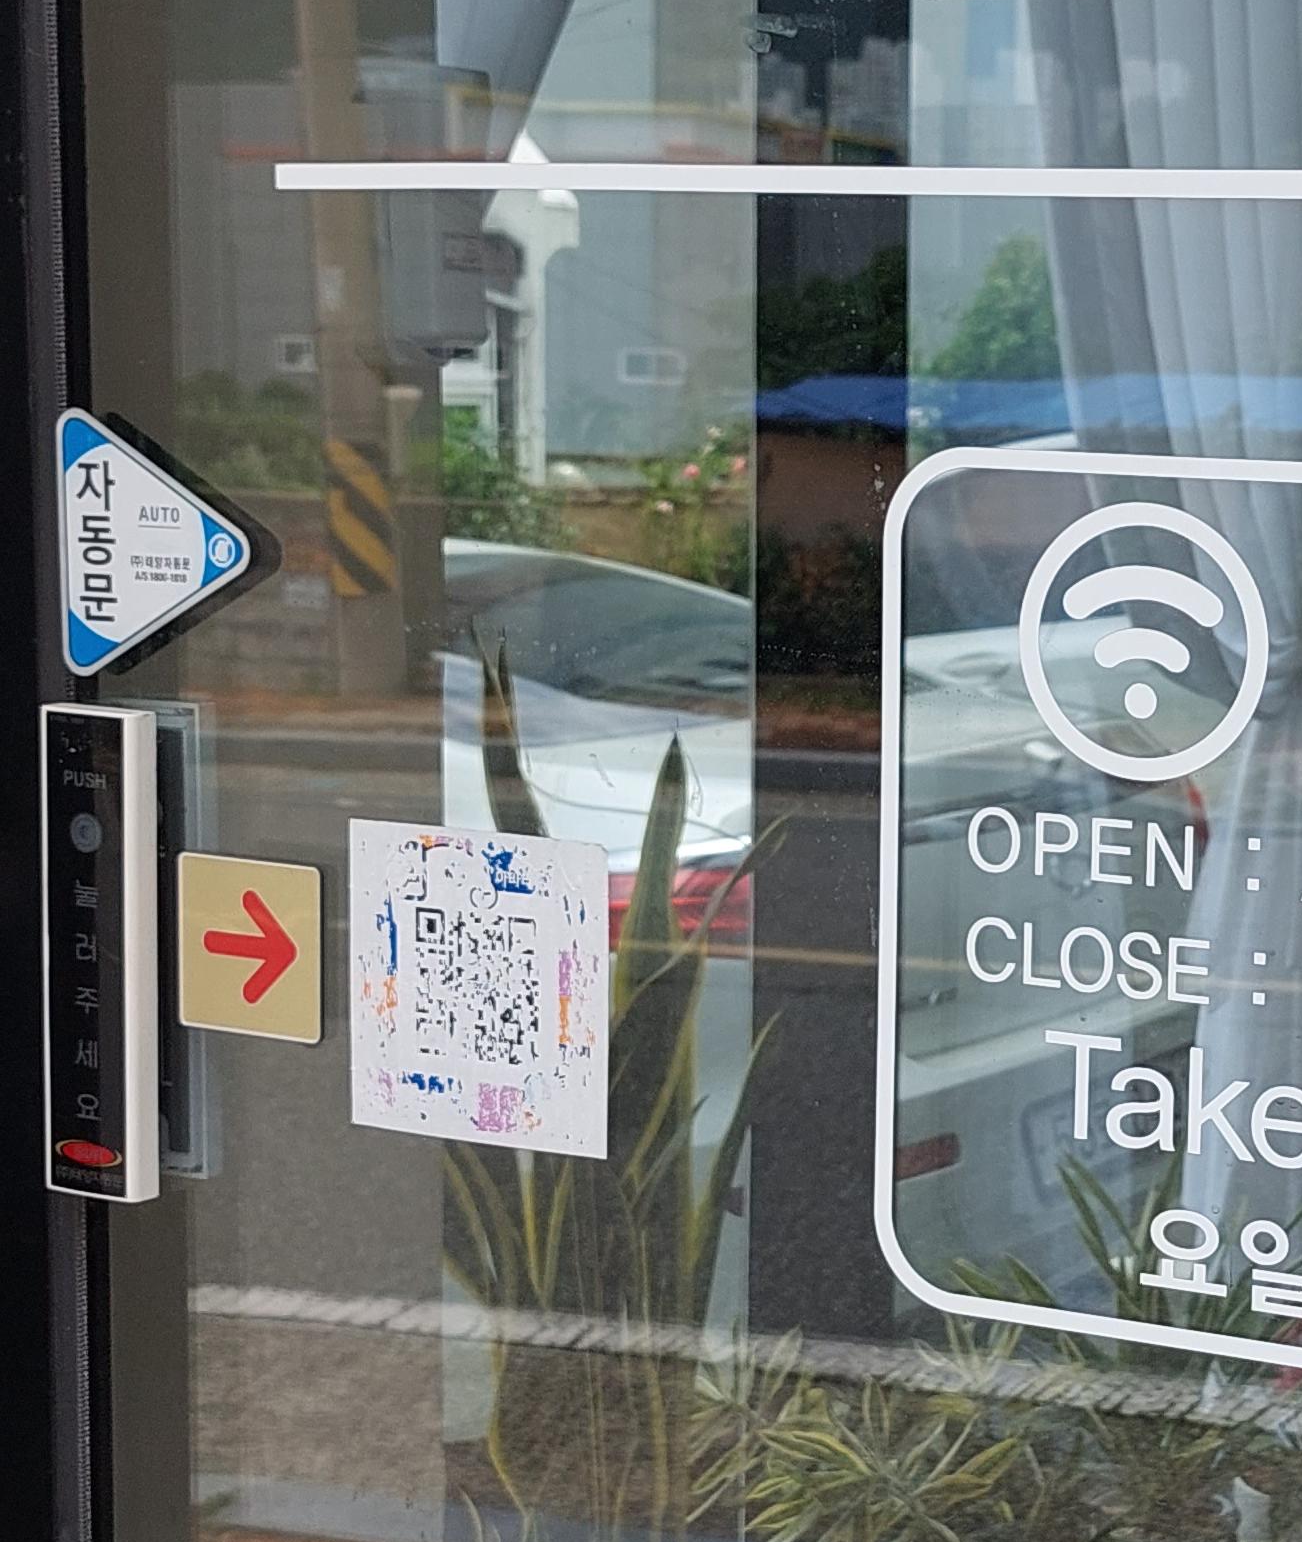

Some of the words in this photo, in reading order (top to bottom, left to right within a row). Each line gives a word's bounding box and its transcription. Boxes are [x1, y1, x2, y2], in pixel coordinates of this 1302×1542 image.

[76, 460, 118, 623] 자동문
[138, 505, 181, 524] AUTO
[63, 769, 107, 791] PUSH
[967, 806, 1197, 892] OPEN
[965, 917, 1211, 1007] CLOSE
